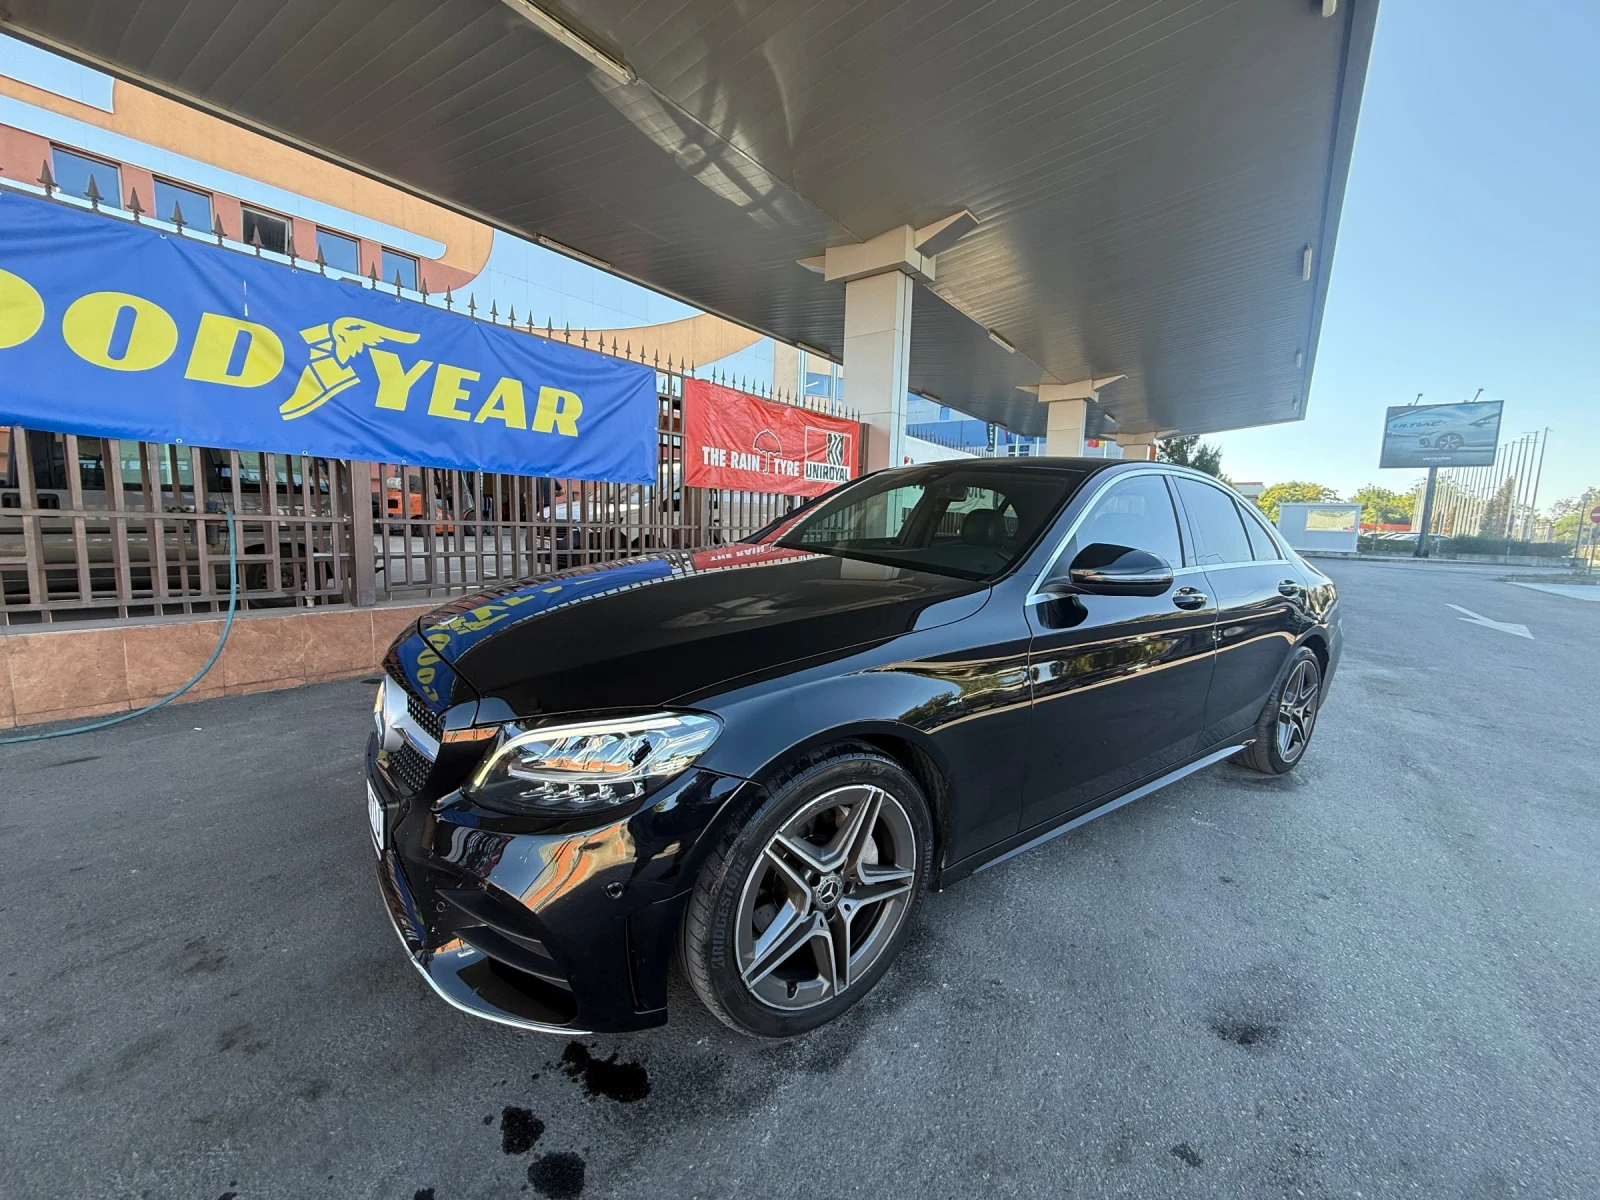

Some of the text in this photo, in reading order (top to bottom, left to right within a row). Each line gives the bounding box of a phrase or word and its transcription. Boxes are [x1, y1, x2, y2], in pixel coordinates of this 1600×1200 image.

[369, 348, 584, 438] YEAR
[702, 446, 799, 477] THE RAIN TYRE
[806, 462, 849, 482] UNIROYAL
[711, 852, 749, 969] BRIDGESTONE
